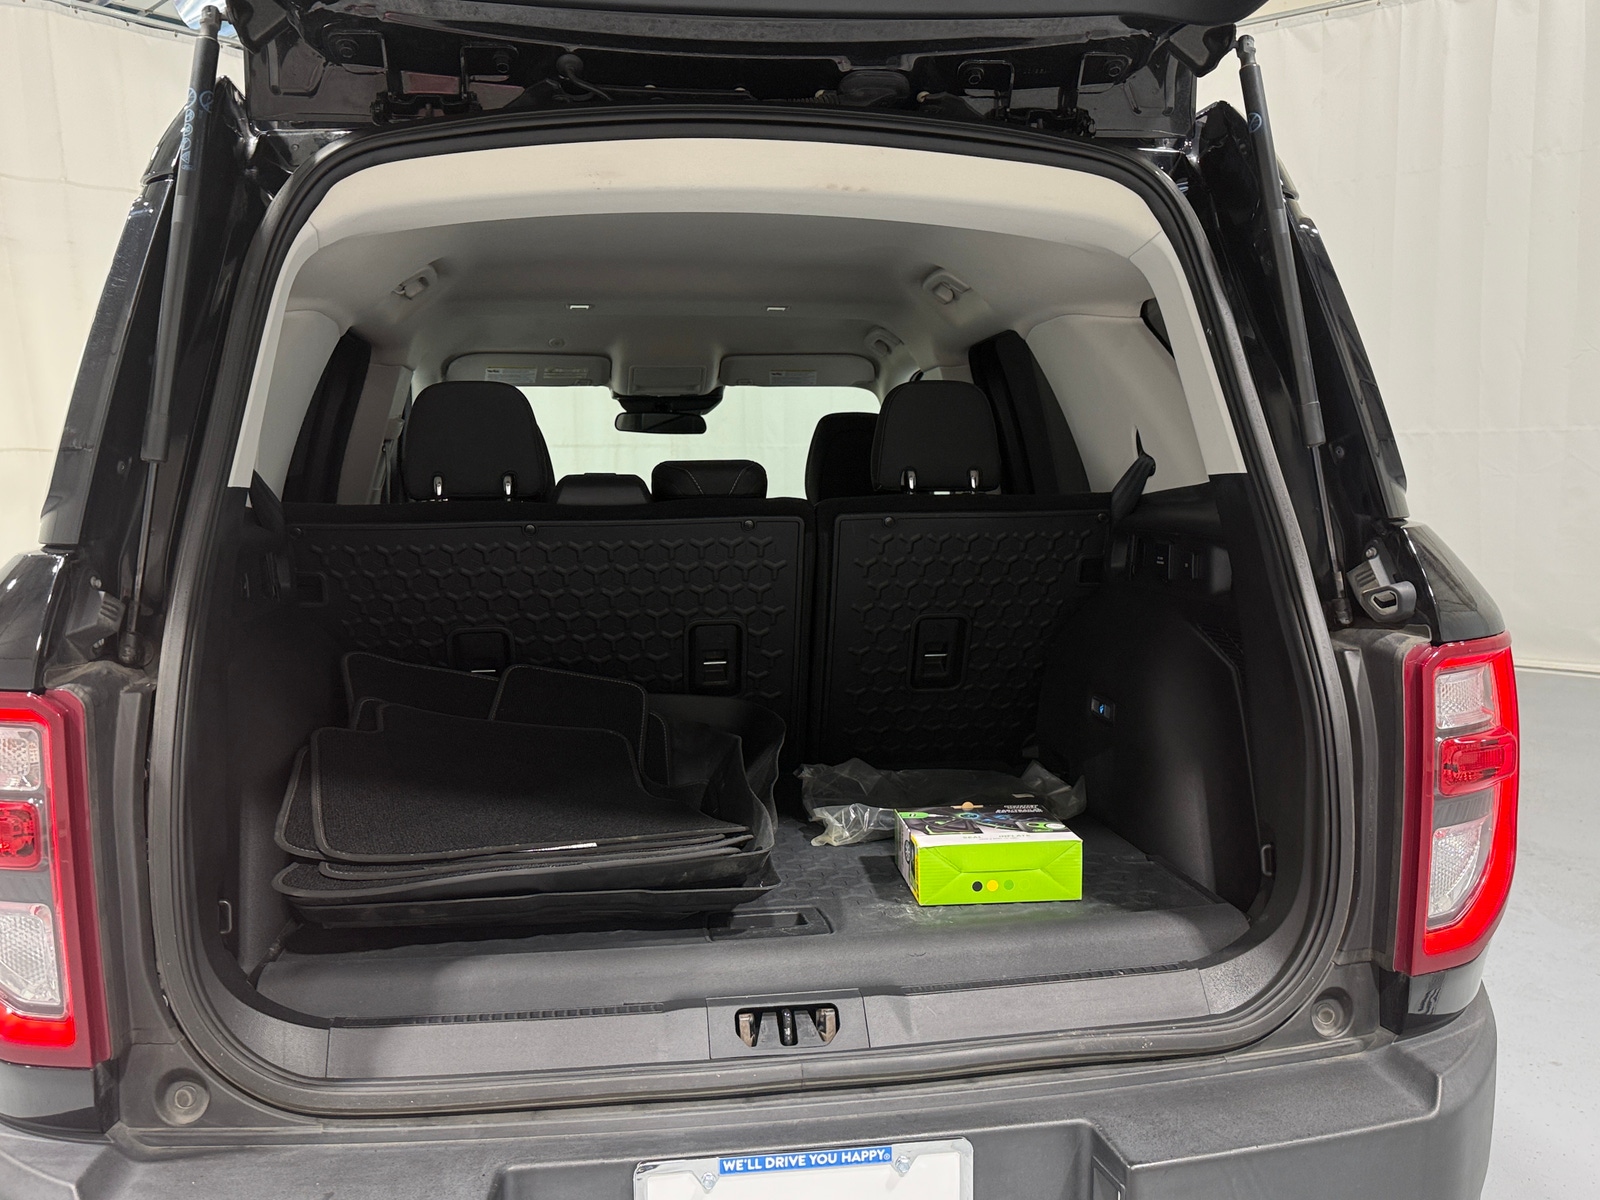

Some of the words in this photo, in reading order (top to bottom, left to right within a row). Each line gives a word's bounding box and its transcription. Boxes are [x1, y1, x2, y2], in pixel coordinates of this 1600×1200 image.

[722, 1158, 763, 1172] WE'LL
[765, 1154, 806, 1169] DRIVE
[808, 1152, 838, 1166] YOU
